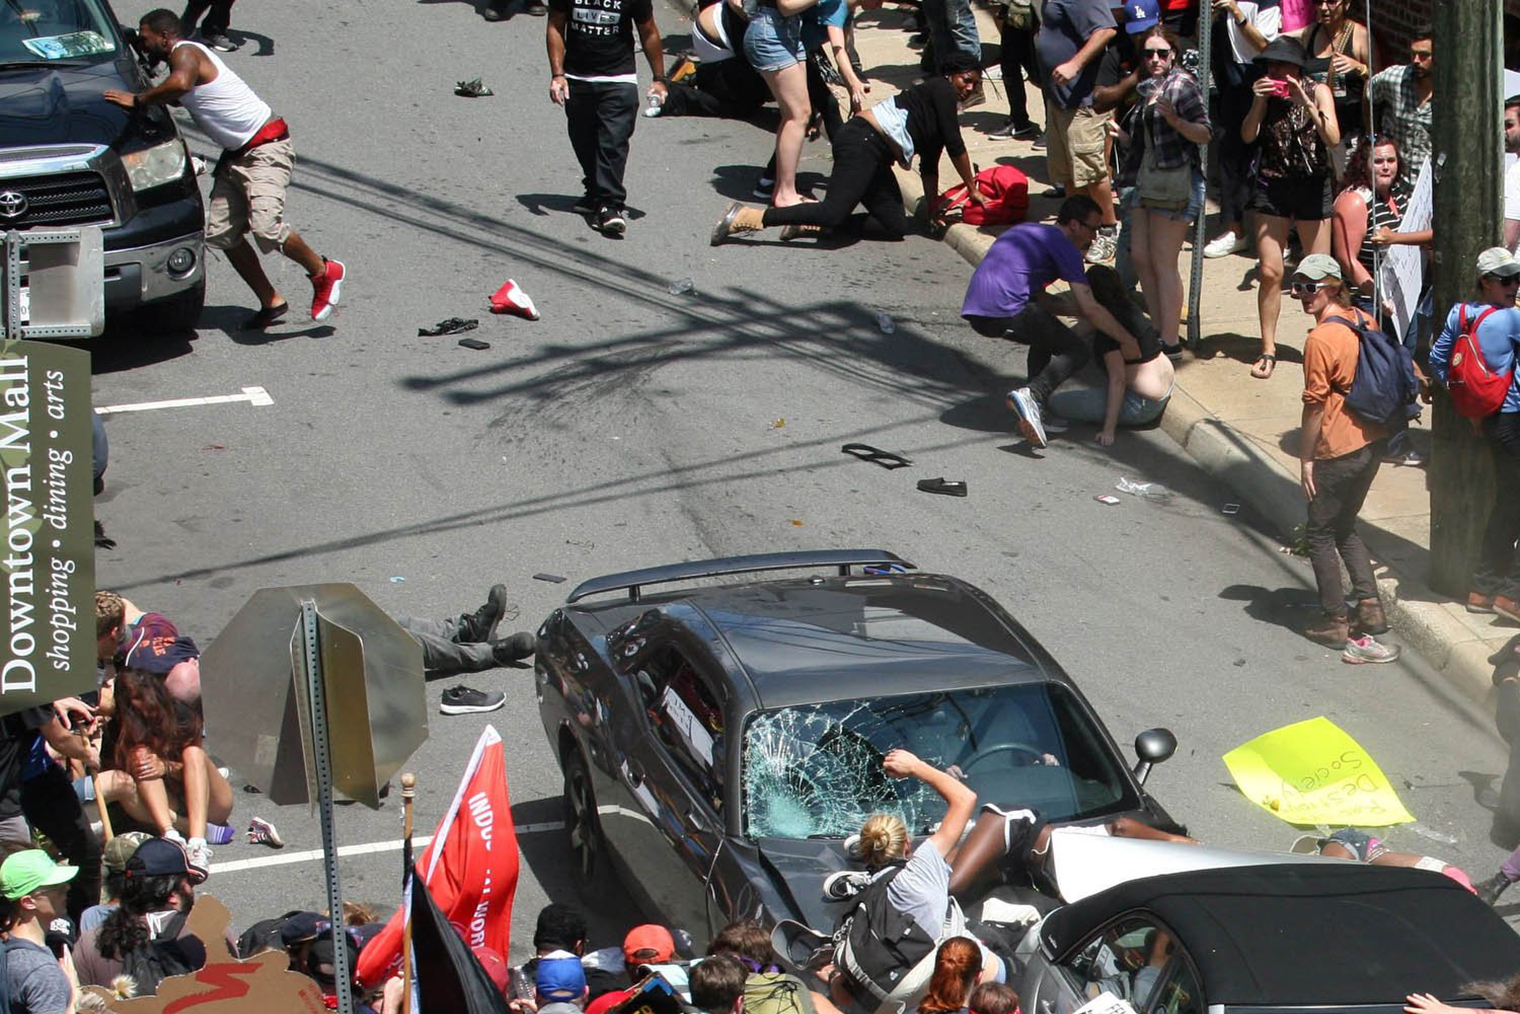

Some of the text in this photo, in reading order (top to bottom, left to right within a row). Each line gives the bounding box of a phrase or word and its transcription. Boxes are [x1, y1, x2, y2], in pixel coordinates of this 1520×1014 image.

[575, 0, 622, 9] BLACK
[577, 12, 616, 22] LIVES
[571, 22, 620, 35] MATTER
[0, 355, 36, 694] Downtown Mall
[43, 370, 77, 671] shopping dining arts
